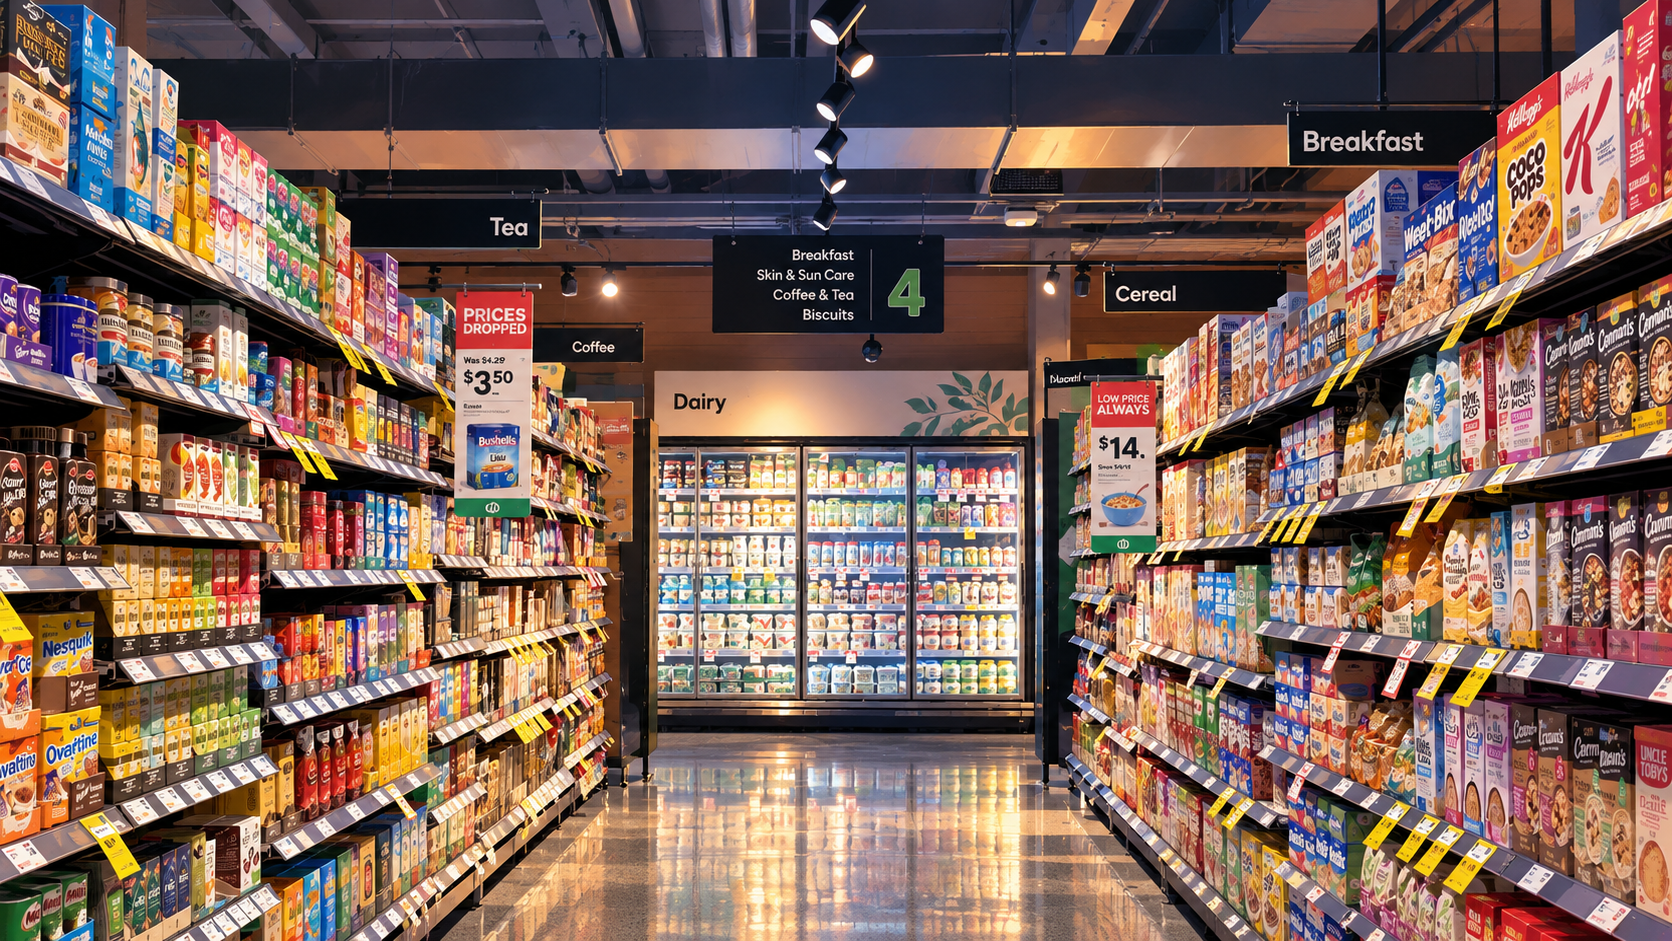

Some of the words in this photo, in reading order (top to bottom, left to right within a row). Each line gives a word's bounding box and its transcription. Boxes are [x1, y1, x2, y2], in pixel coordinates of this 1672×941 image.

[1304, 131, 1424, 152] Breakfast
[1507, 141, 1545, 187] COCO
[1511, 166, 1545, 209] POPS
[490, 217, 528, 236] Tea
[792, 249, 854, 261] Breakfast
[757, 269, 783, 281] Skin
[786, 269, 795, 281] &
[798, 269, 822, 281] Sun
[824, 269, 855, 281] Care
[773, 288, 816, 301] Coffee
[819, 289, 829, 301] &
[831, 289, 855, 301] Tea
[888, 268, 926, 317] 4
[1115, 285, 1176, 302] Cereal
[464, 308, 526, 322] PRICES
[803, 308, 854, 321] Biscuits
[463, 323, 527, 335] DROPPED
[572, 341, 615, 354] Coffee
[463, 356, 480, 364] Was
[673, 393, 726, 413] Dairy
[1097, 395, 1119, 403] LOW
[1121, 395, 1149, 403] PRICE
[1097, 404, 1150, 415] ALWAYS
[43, 631, 92, 658] Nesquik
[1640, 744, 1668, 766] UNCLE
